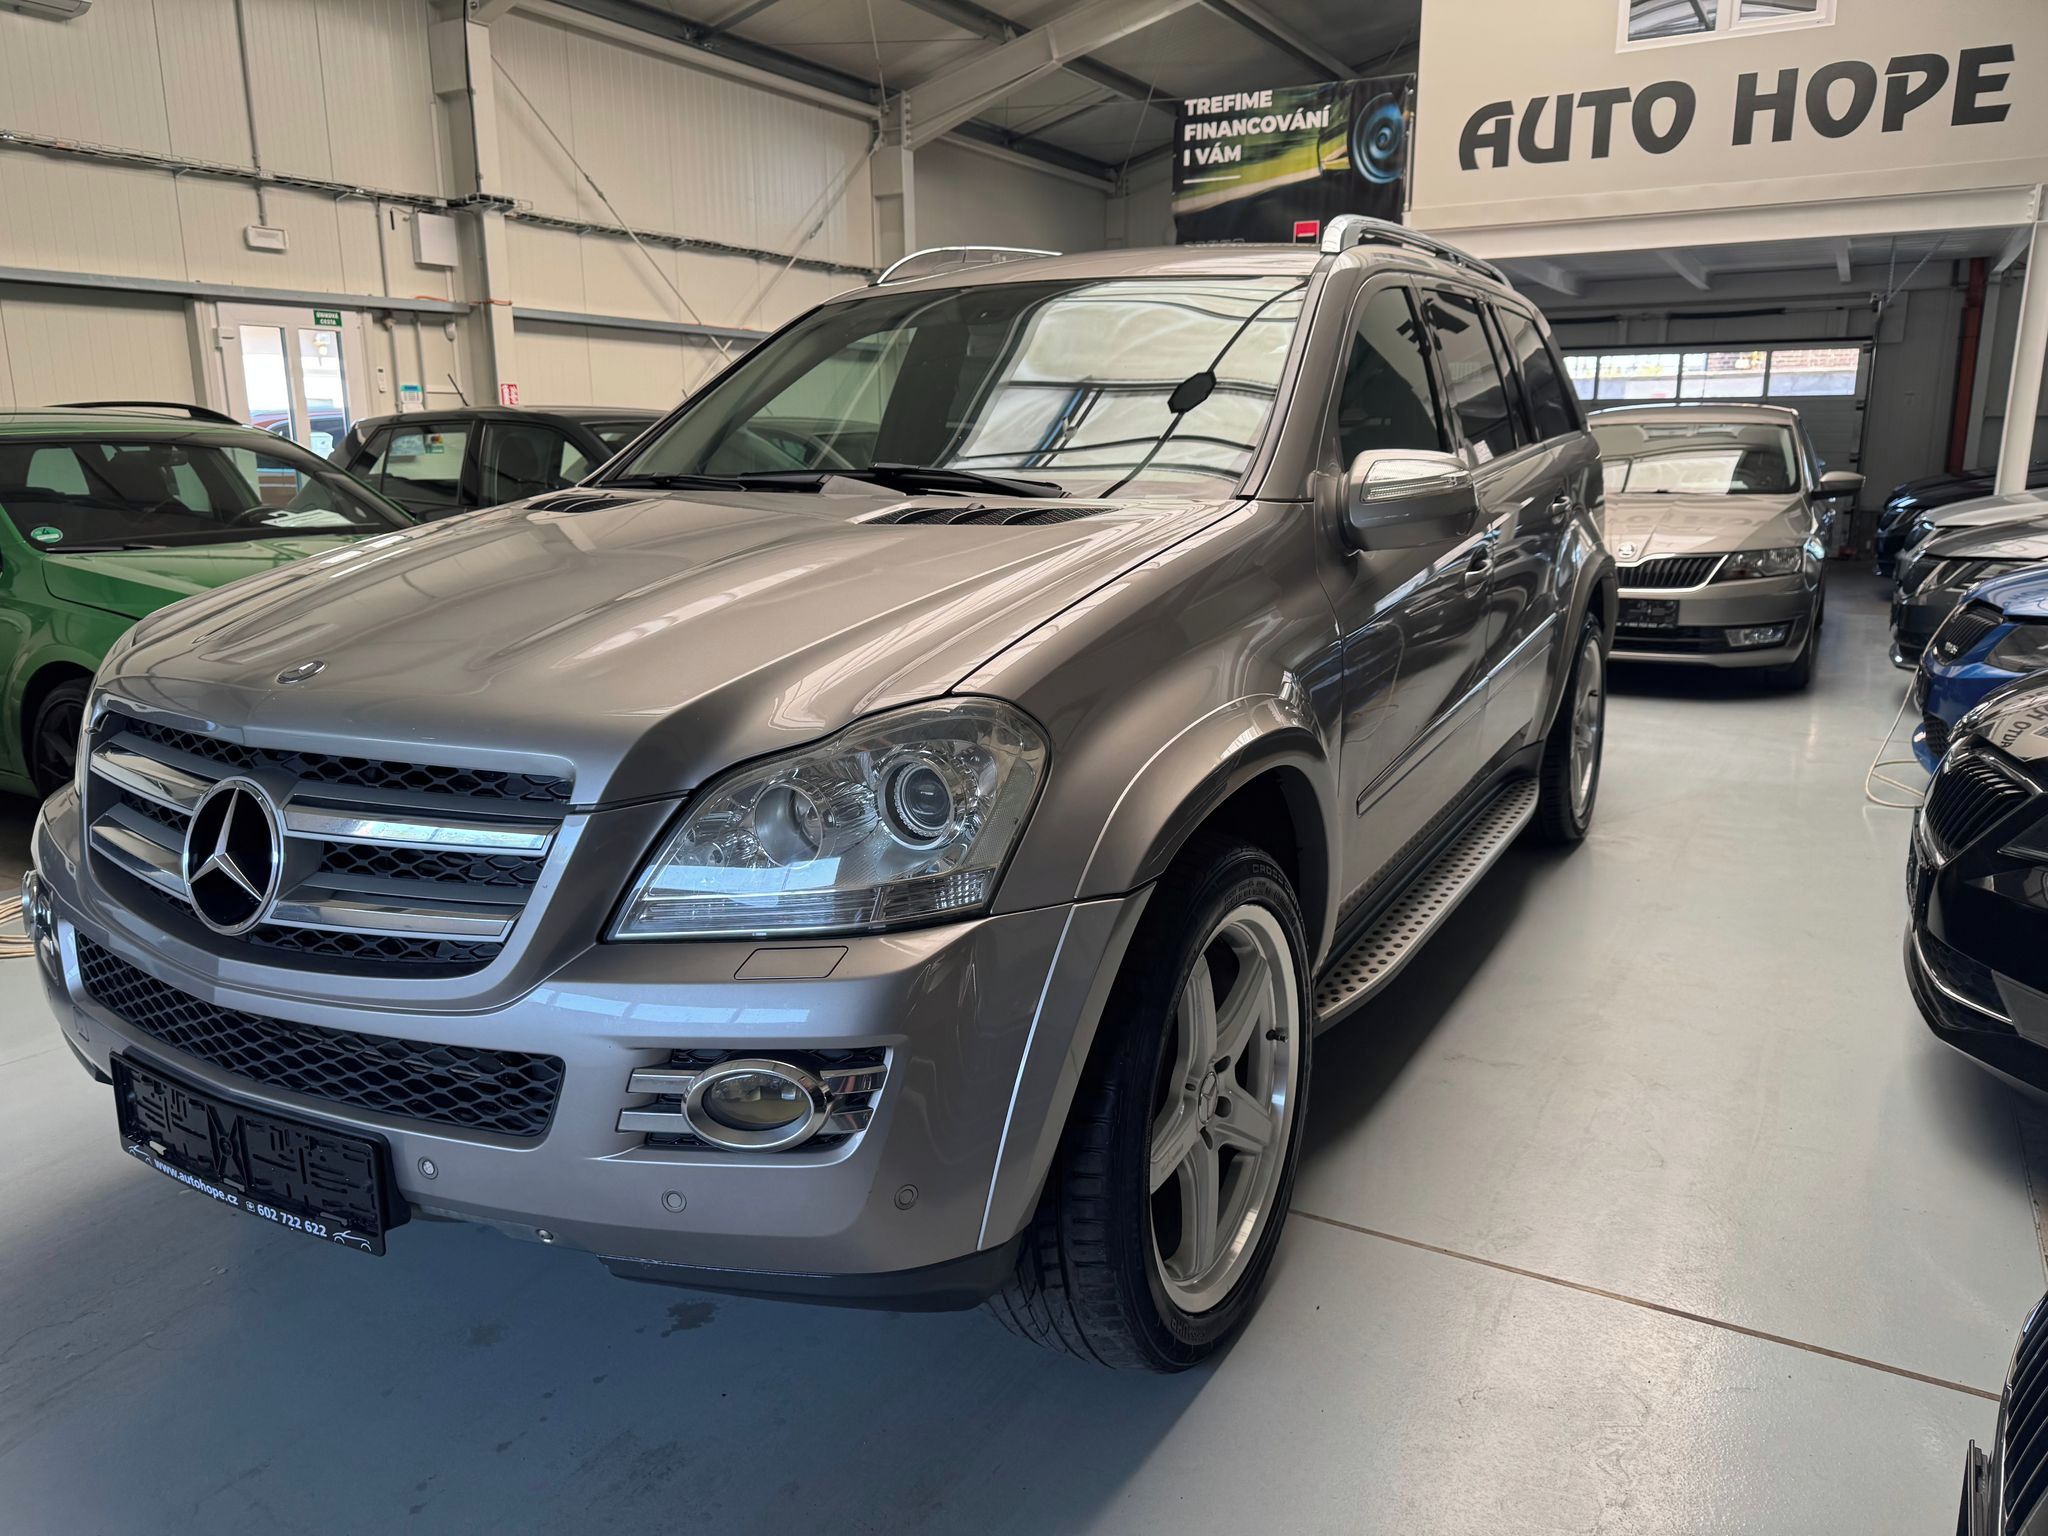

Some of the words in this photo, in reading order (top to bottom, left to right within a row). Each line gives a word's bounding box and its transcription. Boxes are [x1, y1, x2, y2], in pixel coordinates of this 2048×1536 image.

[1184, 90, 1273, 116] TREFIME
[1459, 80, 1696, 171] AUTO
[1731, 43, 2015, 146] HOPE
[1184, 105, 1332, 142] FINANCOVÁNÍ
[1183, 150, 1190, 166] I
[1194, 143, 1242, 165] VÁM
[154, 1159, 239, 1206] www.autohope.cz
[257, 1204, 278, 1221] 602
[280, 1211, 302, 1230] 722
[304, 1220, 328, 1238] 622
